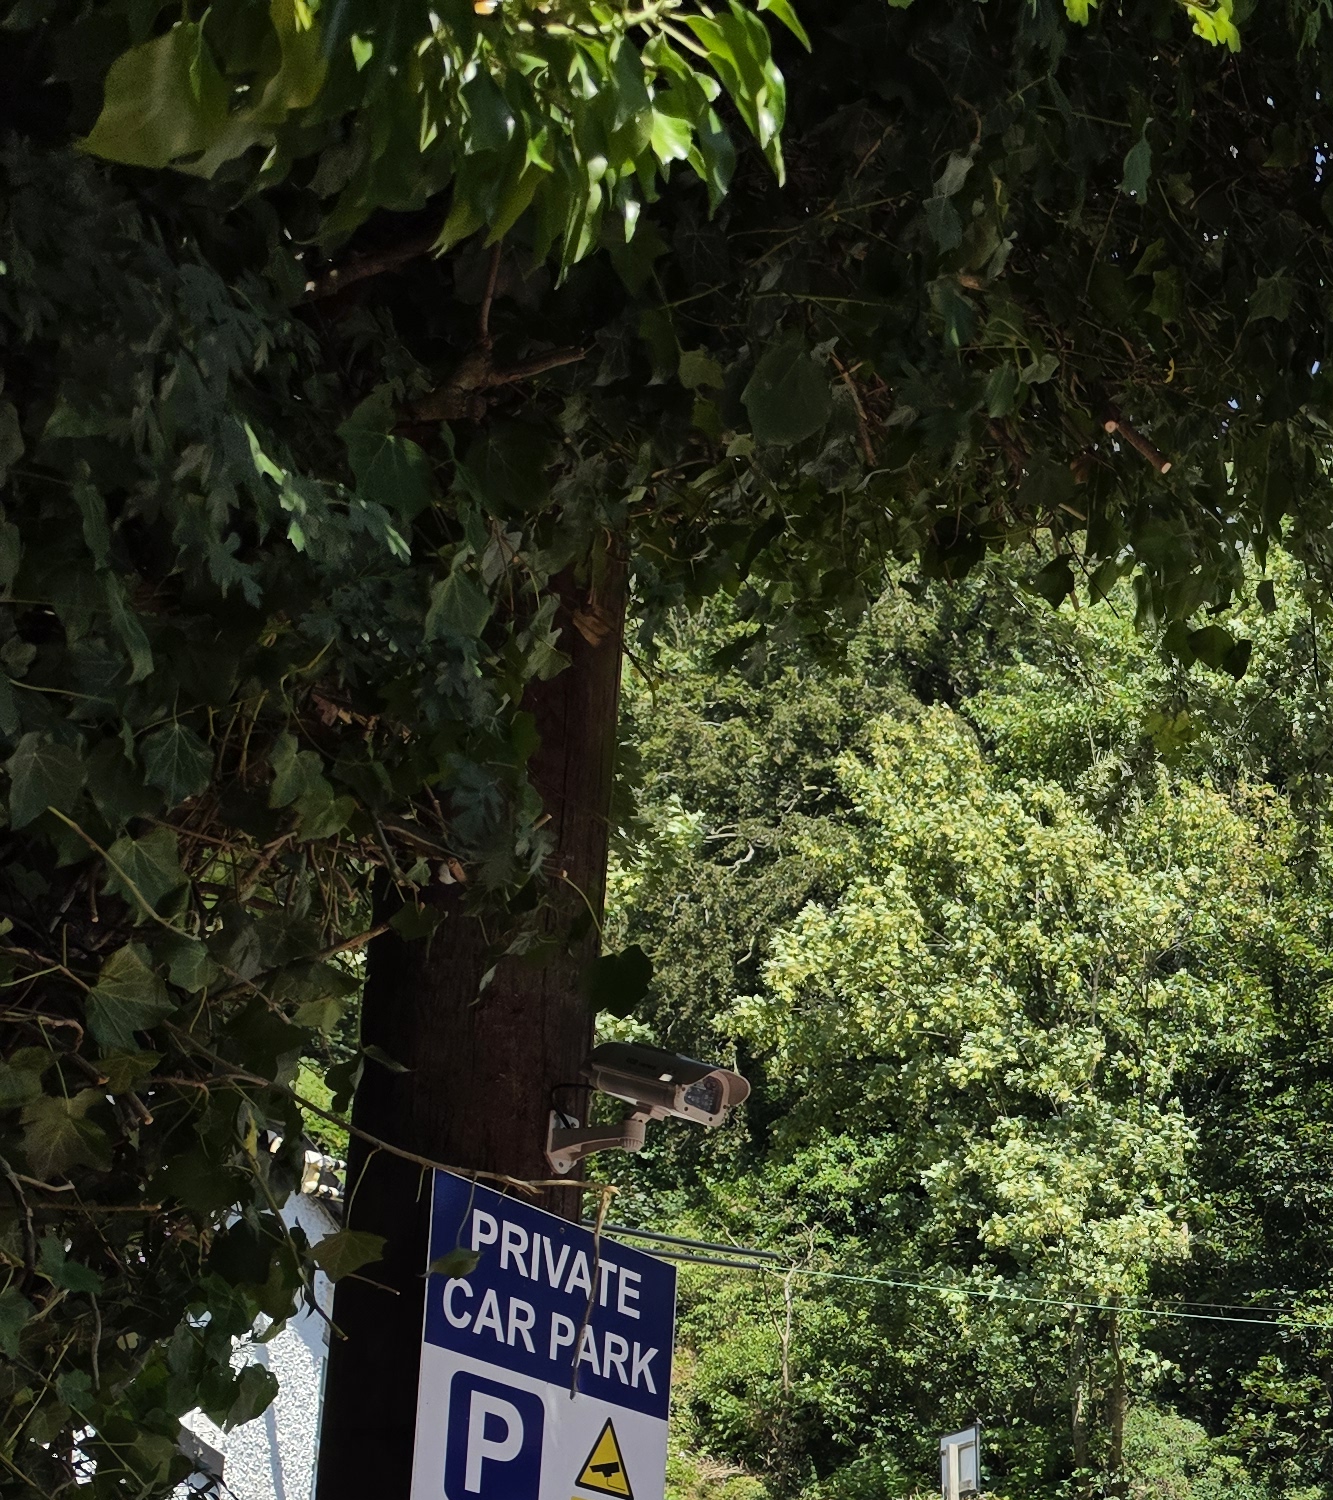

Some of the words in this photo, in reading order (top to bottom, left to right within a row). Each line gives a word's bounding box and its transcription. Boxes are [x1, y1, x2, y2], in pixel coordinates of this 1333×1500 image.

[471, 1208, 642, 1320] PRIVATE
[442, 1277, 536, 1354] CAR
[549, 1311, 659, 1395] PARK
[464, 1389, 525, 1494] P
